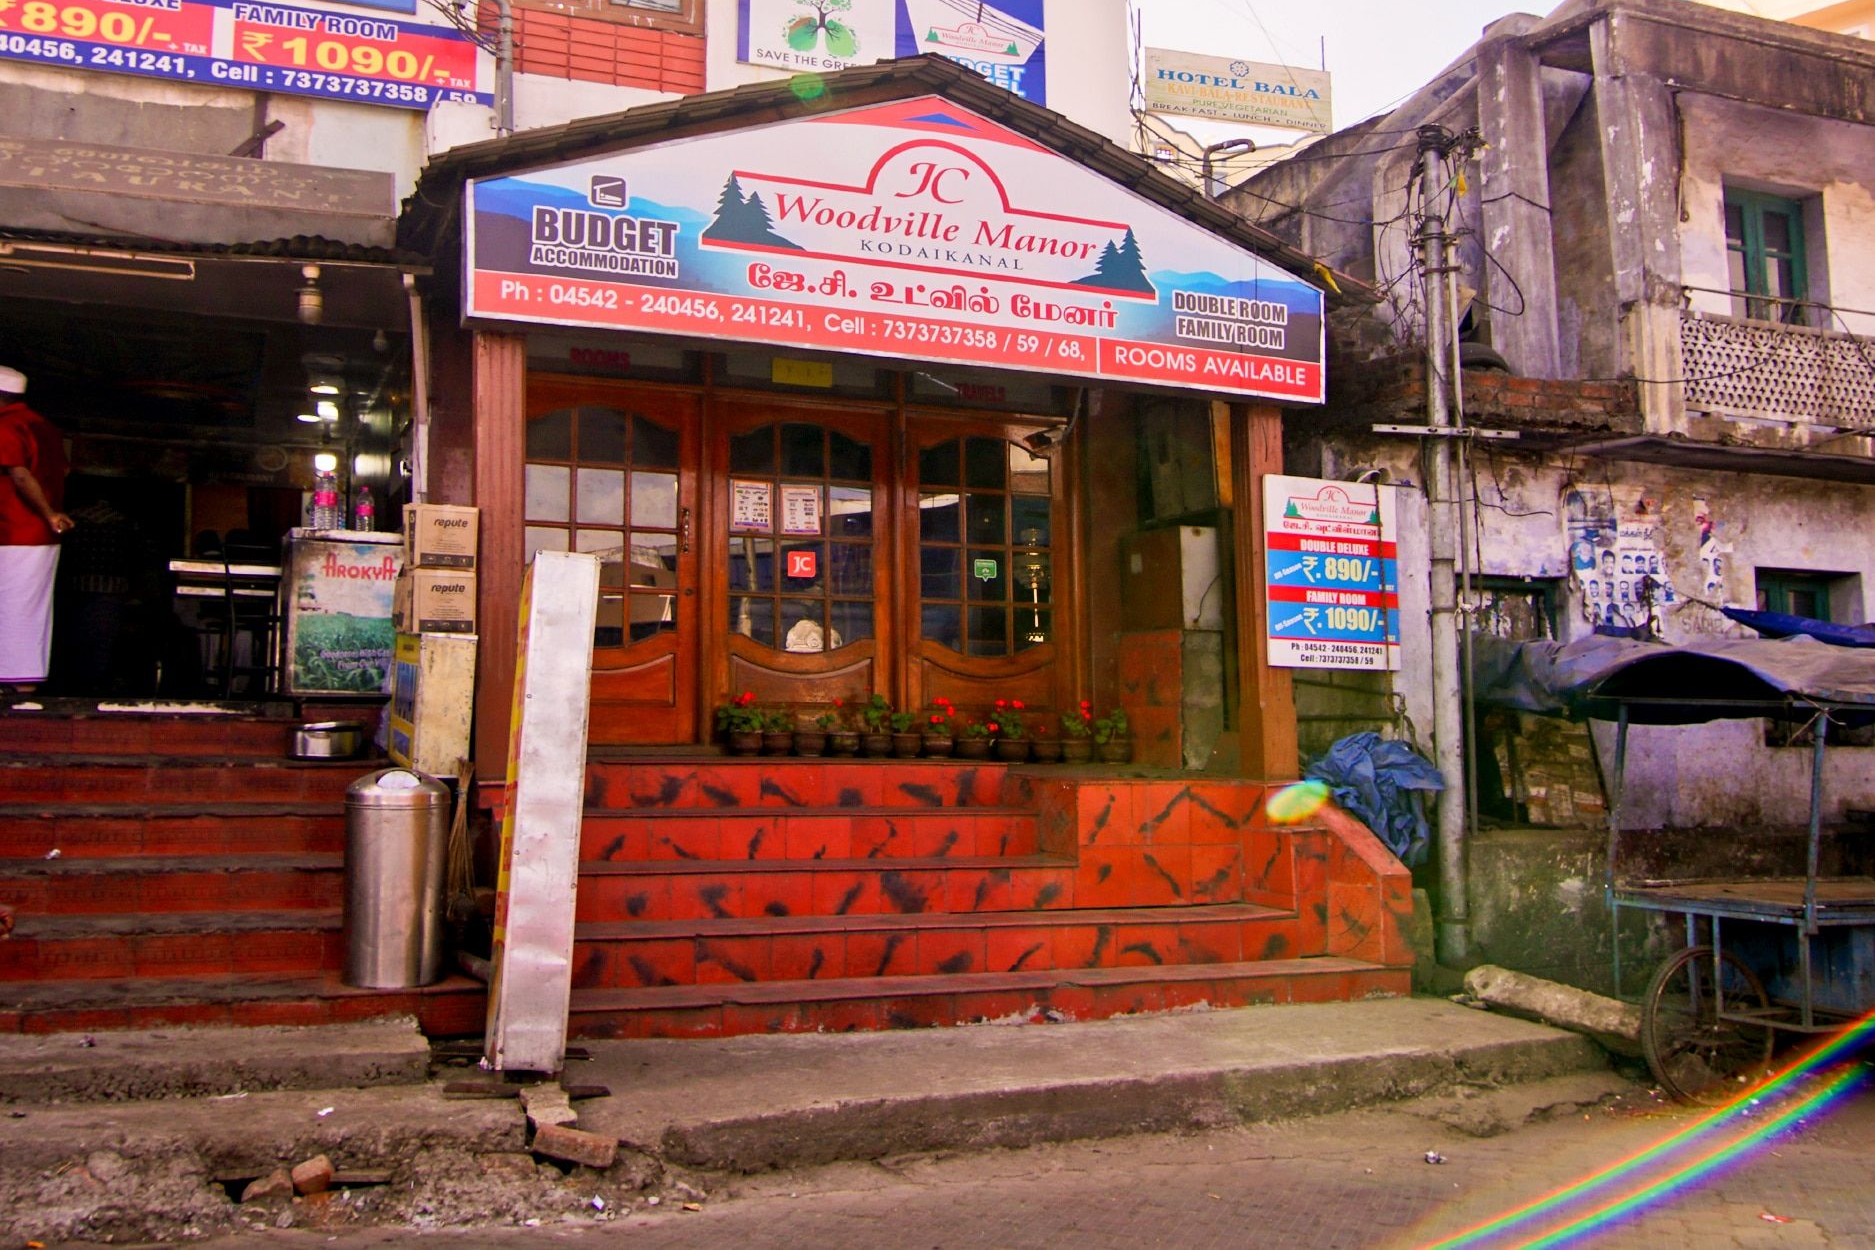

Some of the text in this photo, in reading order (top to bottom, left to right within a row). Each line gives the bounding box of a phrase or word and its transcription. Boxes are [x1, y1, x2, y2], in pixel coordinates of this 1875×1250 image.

[233, 3, 396, 41] FAMILY ROOM
[183, 42, 207, 55] TAX
[756, 48, 860, 71] SAVE THE GRE
[91, 47, 196, 78] 241241,
[211, 61, 258, 83] Cell
[282, 69, 428, 102] 7373737358
[945, 55, 1026, 82] DGET
[450, 78, 472, 89] TAX
[1157, 69, 1320, 100] HOTEL BALA
[1152, 102, 1189, 113] BREAK
[1233, 112, 1271, 123] LUNCH
[1192, 99, 1288, 117] PURE VEGETARIAN
[535, 207, 678, 256] BUDGET
[774, 192, 1097, 260] Woodville Manor
[533, 246, 676, 277] ACCOMMODATION
[860, 238, 1025, 271] KODAIKANAL
[1174, 291, 1285, 323] DOUBLE ROOM
[501, 279, 529, 301] Ph
[550, 284, 618, 310] 04542
[641, 294, 725, 323] 240456,
[731, 303, 812, 333] 241241,
[824, 313, 865, 336] Cell
[883, 318, 997, 349] 7373737358
[1017, 335, 1039, 354] 59
[1058, 340, 1086, 362] 68,
[1178, 317, 1283, 348] FAMILY ROOM
[1115, 345, 1306, 386] ROOMS AVAILABLE
[1300, 501, 1367, 517] Woodville Manor
[433, 517, 469, 529] repute
[1300, 539, 1370, 555] DOUBLE DELUXE
[792, 555, 812, 573] JC
[1325, 557, 1379, 583] 890/-
[431, 583, 466, 595] repute
[1306, 590, 1366, 606] FAMILY ROOM
[1325, 606, 1385, 633] 1090/-
[1291, 642, 1300, 651] Ph
[1301, 654, 1315, 663] Cell
